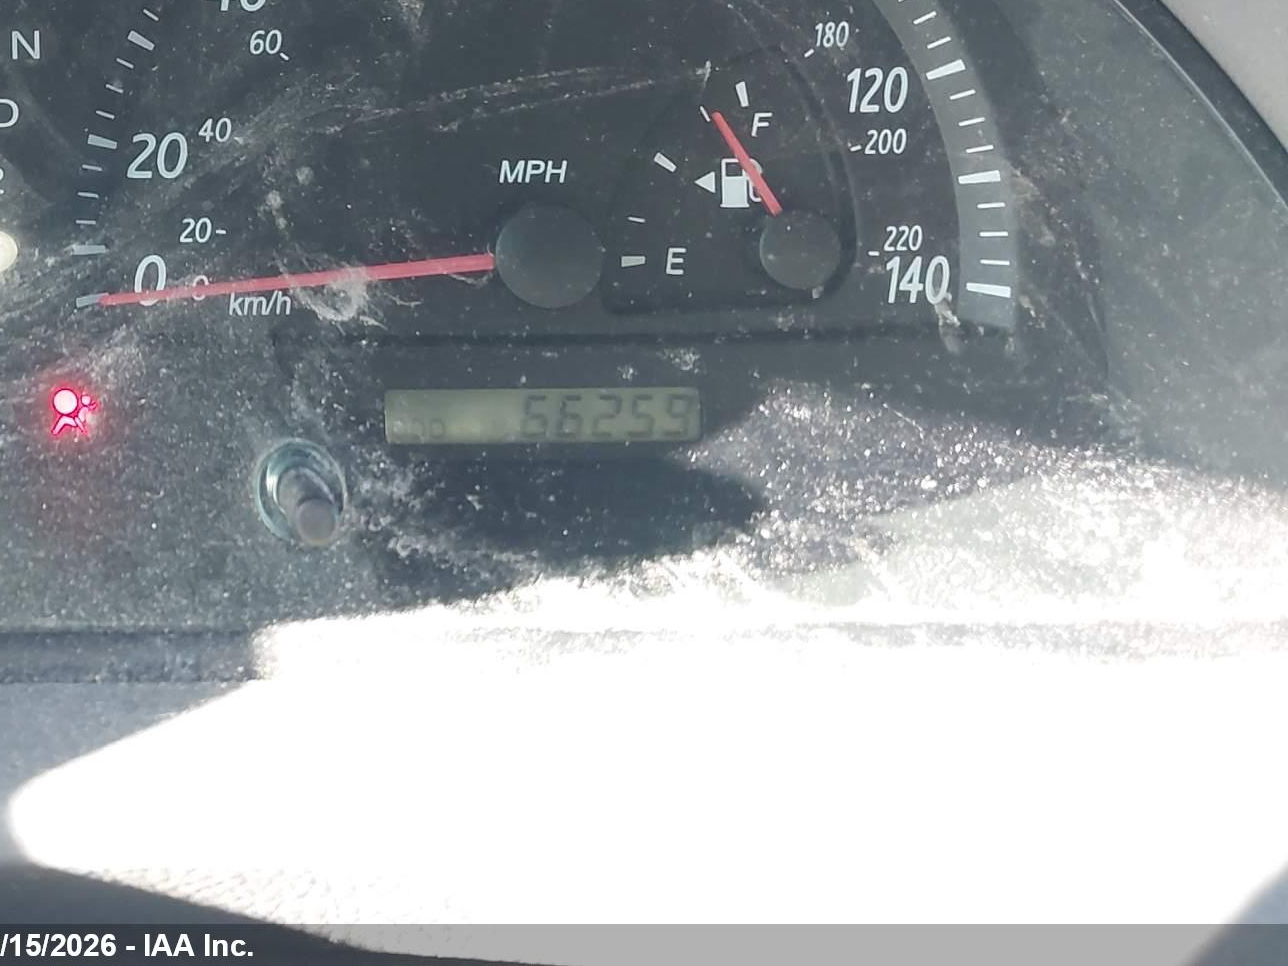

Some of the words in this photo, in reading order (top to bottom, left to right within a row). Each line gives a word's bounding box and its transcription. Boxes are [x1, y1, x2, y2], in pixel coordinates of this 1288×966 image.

[11, 30, 40, 60] N
[249, 30, 282, 55] 60
[814, 21, 849, 47] 180
[846, 67, 908, 114] 120
[198, 117, 232, 142] 40
[751, 112, 773, 136] F
[864, 129, 907, 155] 200
[126, 132, 188, 179] 20
[499, 160, 568, 183] MPH
[179, 217, 212, 243] 20
[883, 225, 923, 252] 220
[665, 247, 686, 275] E
[134, 255, 166, 306] 0
[885, 256, 950, 304] 140
[228, 290, 292, 316] km/h
[521, 394, 693, 438] 66259
